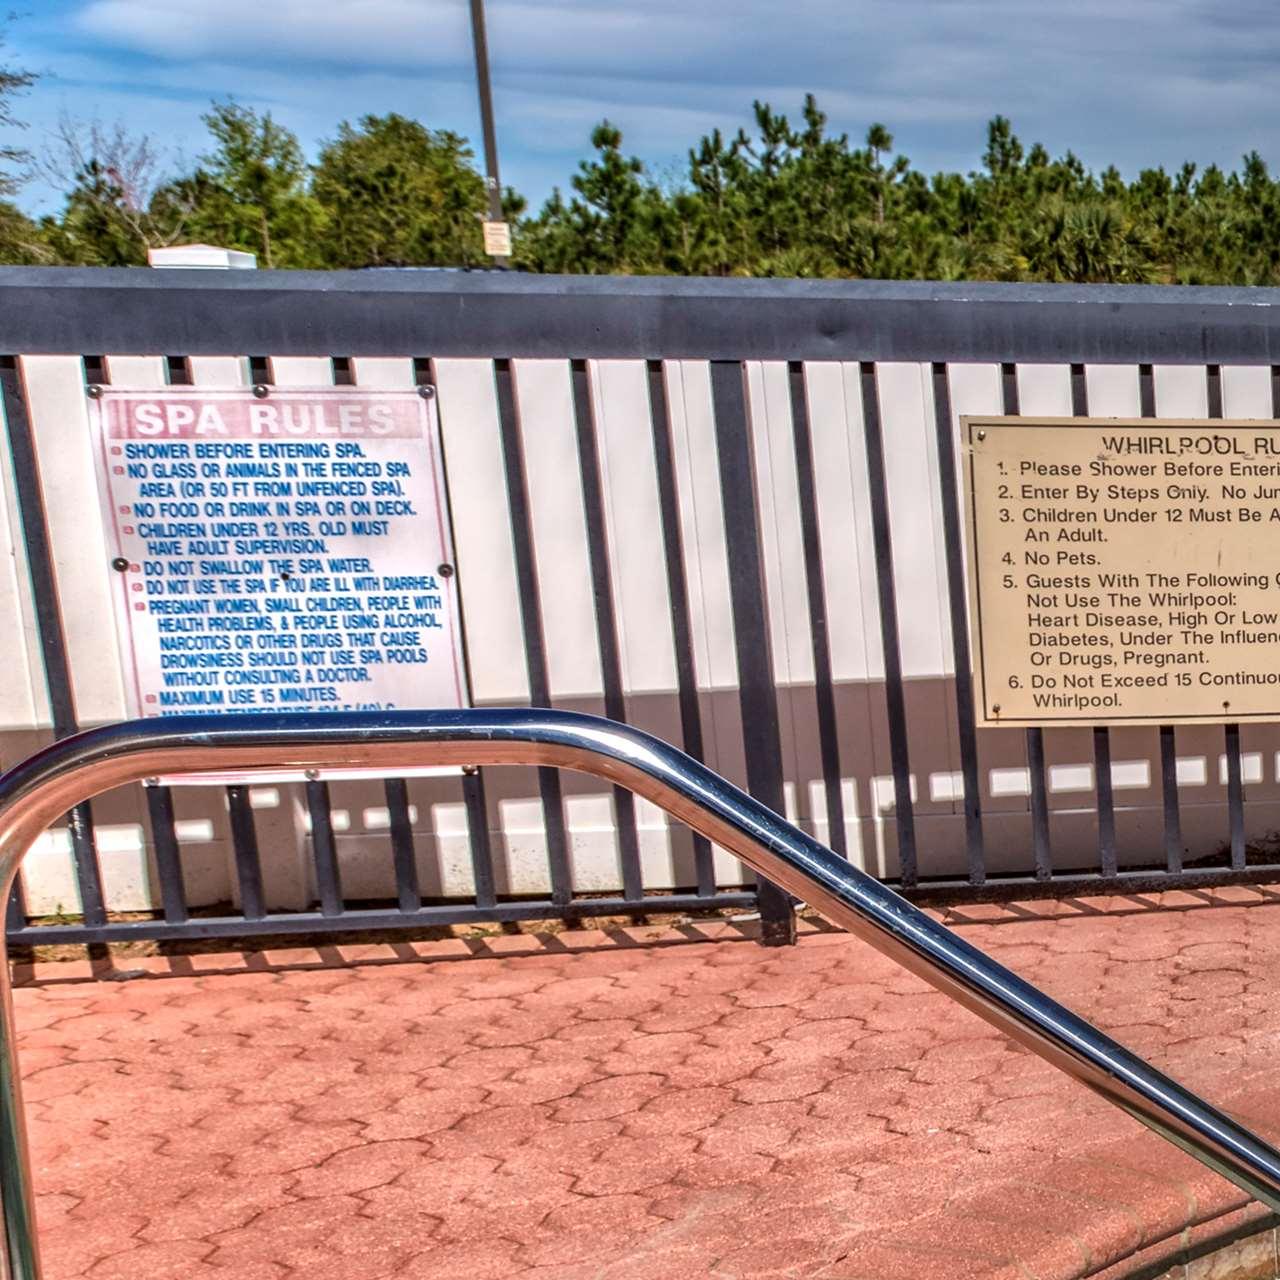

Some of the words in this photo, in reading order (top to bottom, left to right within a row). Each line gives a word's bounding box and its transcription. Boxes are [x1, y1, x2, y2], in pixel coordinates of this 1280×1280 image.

[135, 404, 227, 435] SPA
[250, 404, 395, 435] RULES
[123, 442, 191, 459] SHOWER
[191, 442, 253, 459] BEFORE
[257, 442, 332, 459] ENTERING
[334, 441, 367, 458] SPA.
[1101, 435, 1245, 455] WHIRLPOOL
[126, 462, 149, 479] NO
[151, 462, 199, 479] GLASS
[199, 462, 221, 478] OR
[223, 462, 282, 478] ANIMALS
[283, 462, 300, 478] IN
[302, 461, 326, 478] THE
[330, 461, 383, 477] FENCED
[384, 461, 410, 477] SPA
[1019, 460, 1082, 476] Please
[1088, 460, 1157, 476] Shower
[1163, 461, 1223, 476] Before
[137, 481, 176, 498] AREA
[178, 480, 206, 497] (OR
[207, 481, 229, 497] 50
[230, 480, 250, 496] FT
[252, 480, 294, 497] FROM
[296, 479, 367, 497] UNFENCED
[370, 479, 404, 496] SPA).
[997, 484, 1013, 499] 2.
[1020, 483, 1069, 499] Enter
[1075, 484, 1099, 503] By
[1107, 484, 1159, 503] Steps
[1221, 484, 1246, 499] No
[132, 502, 157, 517] NO
[158, 501, 200, 518] FOOD
[202, 501, 226, 518] OR
[227, 500, 273, 517] DRINK
[274, 501, 291, 516] IN
[293, 500, 322, 516] SPA
[324, 499, 346, 516] OR
[350, 499, 373, 516] ON
[374, 499, 419, 516] DECK.
[999, 507, 1014, 522] 3.
[1022, 507, 1097, 522] Children
[1102, 507, 1157, 523] Under
[1164, 507, 1182, 522] 12
[1188, 507, 1231, 522] Must
[1238, 507, 1261, 522] Be
[137, 521, 208, 539] CHILDREN
[210, 521, 260, 538] UNDER
[262, 520, 278, 538] 12
[282, 520, 313, 537] YRS.
[318, 520, 347, 537] OLD
[350, 519, 389, 536] MUST
[1024, 527, 1049, 542] An
[1056, 527, 1108, 542] Adult.
[146, 540, 182, 556] HAVE
[185, 539, 229, 556] ADULT
[234, 538, 329, 555] SUPERVISION.
[143, 560, 164, 576] DO
[166, 560, 194, 576] NOT
[199, 559, 265, 576] SWALLOW
[267, 558, 294, 574] THE
[298, 558, 324, 574] SPA
[326, 557, 373, 573] WATER.
[1001, 551, 1015, 565] 4.
[1024, 550, 1050, 565] No
[1056, 550, 1101, 565] Pets.
[1002, 574, 1018, 589] 5.
[1025, 573, 1090, 588] Guests
[1096, 573, 1139, 588] With
[1145, 572, 1180, 587] The
[1186, 572, 1269, 590] Following
[147, 598, 210, 615] PREGNANT
[212, 597, 264, 614] WOMEN,
[264, 597, 302, 613] SMALL
[306, 595, 367, 613] CHILDREN,
[366, 594, 410, 611] PEOPLE
[413, 594, 442, 610] WITH
[1026, 593, 1058, 608] Not
[1064, 592, 1100, 608] Use
[1106, 592, 1141, 607] The
[1147, 591, 1236, 609] Whirlpool:
[1027, 612, 1078, 627] Heart
[1085, 612, 1162, 628] Disease,
[1168, 611, 1208, 629] High
[1213, 610, 1236, 625] Or
[1241, 610, 1278, 625] Low
[158, 634, 231, 651] NARCOTICS
[234, 634, 254, 649] OR
[255, 633, 298, 649] OTHER
[299, 632, 343, 649] DRUGS
[346, 631, 375, 647] THAT
[379, 630, 420, 647] CAUSE
[1028, 631, 1113, 648] Diabetes,
[1119, 630, 1173, 646] Under
[1179, 630, 1214, 644] The
[159, 651, 245, 669] DROWSINESS
[246, 650, 299, 667] SHOULD
[299, 649, 326, 666] NOT
[330, 649, 355, 665] USE
[358, 648, 384, 665] SPA
[385, 648, 428, 663] POOLS
[1029, 650, 1052, 666] Or
[1058, 651, 1117, 669] Drugs,
[1123, 650, 1209, 668] Pregnant.
[162, 670, 221, 687] WITHOUT
[223, 667, 301, 685] CONSULTING
[303, 669, 315, 682] A
[316, 666, 371, 683] DOCTOR.
[1007, 674, 1023, 689] 6.
[1030, 673, 1057, 688] Do
[1062, 673, 1094, 688] Not
[1100, 672, 1167, 688] Exceed
[1174, 672, 1192, 686] 15
[158, 689, 225, 706] MAXIMUM
[228, 688, 255, 704] USE
[260, 687, 275, 703] 15
[277, 685, 339, 703] MINUTES.
[1032, 692, 1122, 710] Whirlpool.
